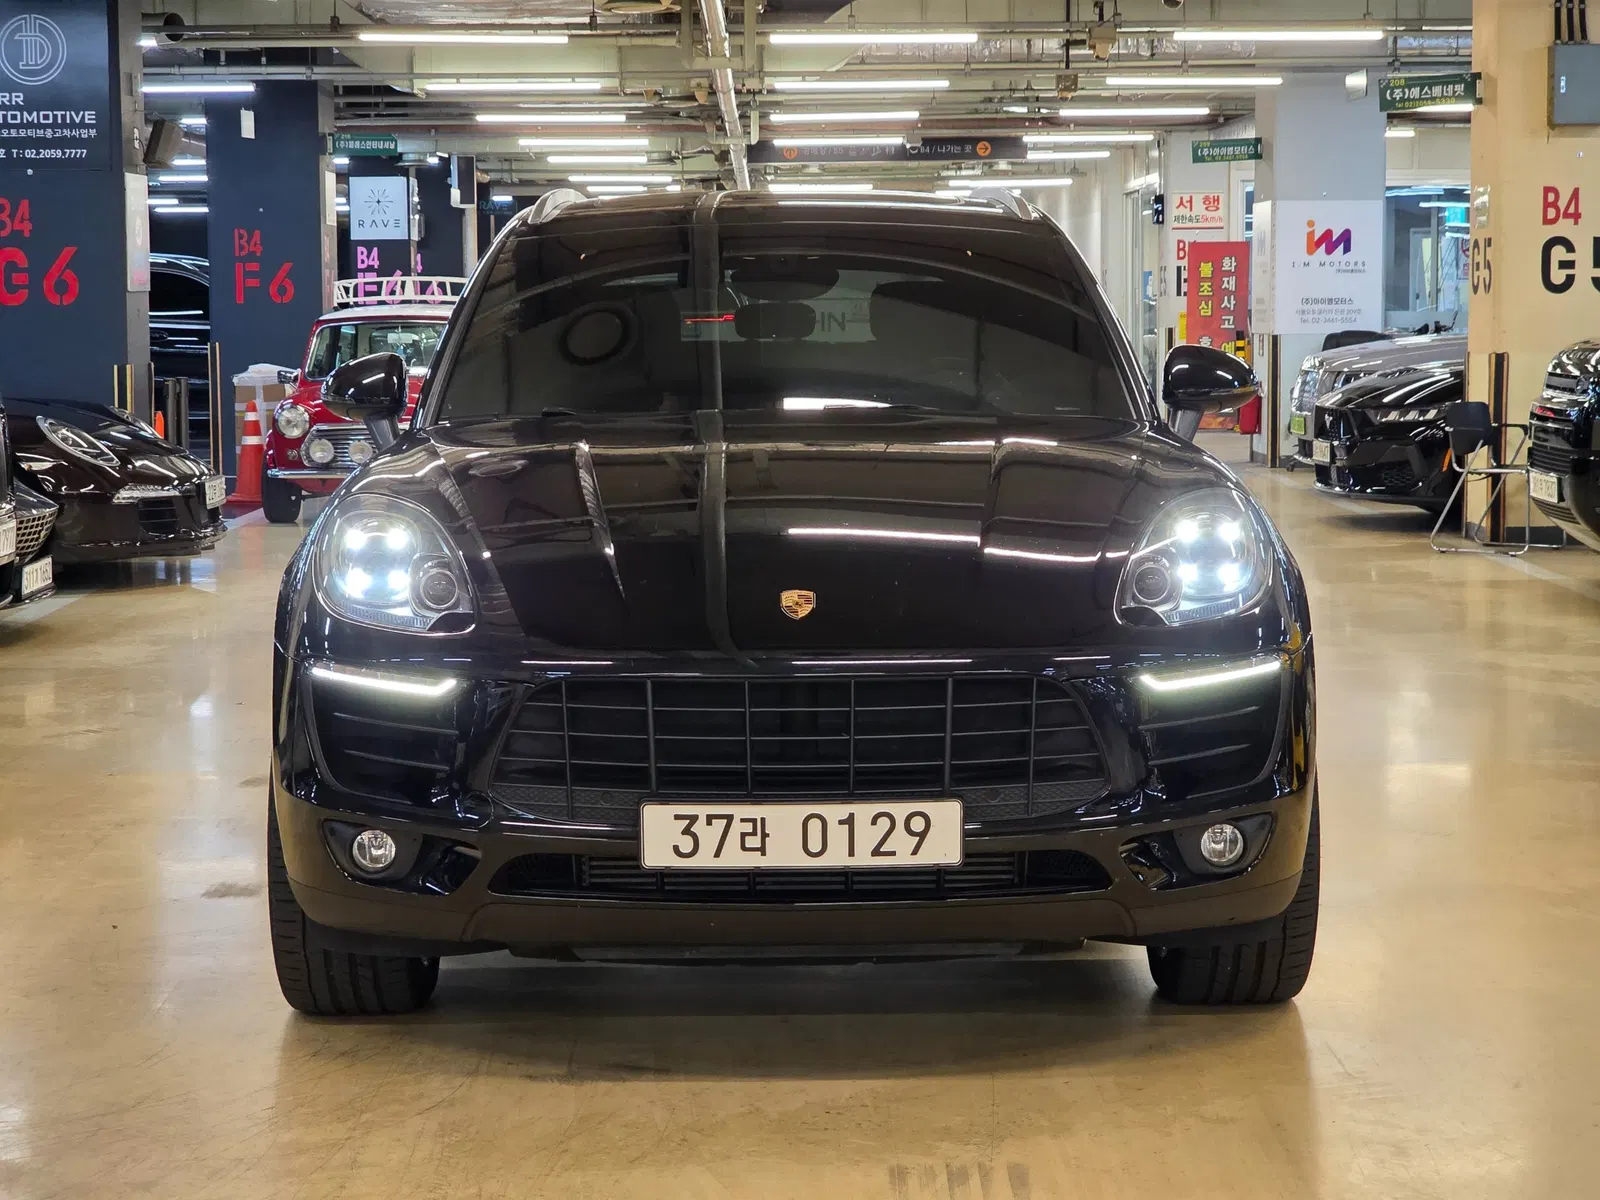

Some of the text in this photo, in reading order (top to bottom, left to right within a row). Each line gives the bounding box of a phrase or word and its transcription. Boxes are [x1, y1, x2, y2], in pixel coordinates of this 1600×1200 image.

[358, 219, 401, 229] RAVE
[1542, 186, 1582, 226] B4
[234, 228, 264, 257] B4
[357, 246, 380, 269] B4
[1198, 261, 1214, 317] 불조심
[1220, 256, 1237, 329] 화재사고
[672, 810, 932, 859] 37라 0129
